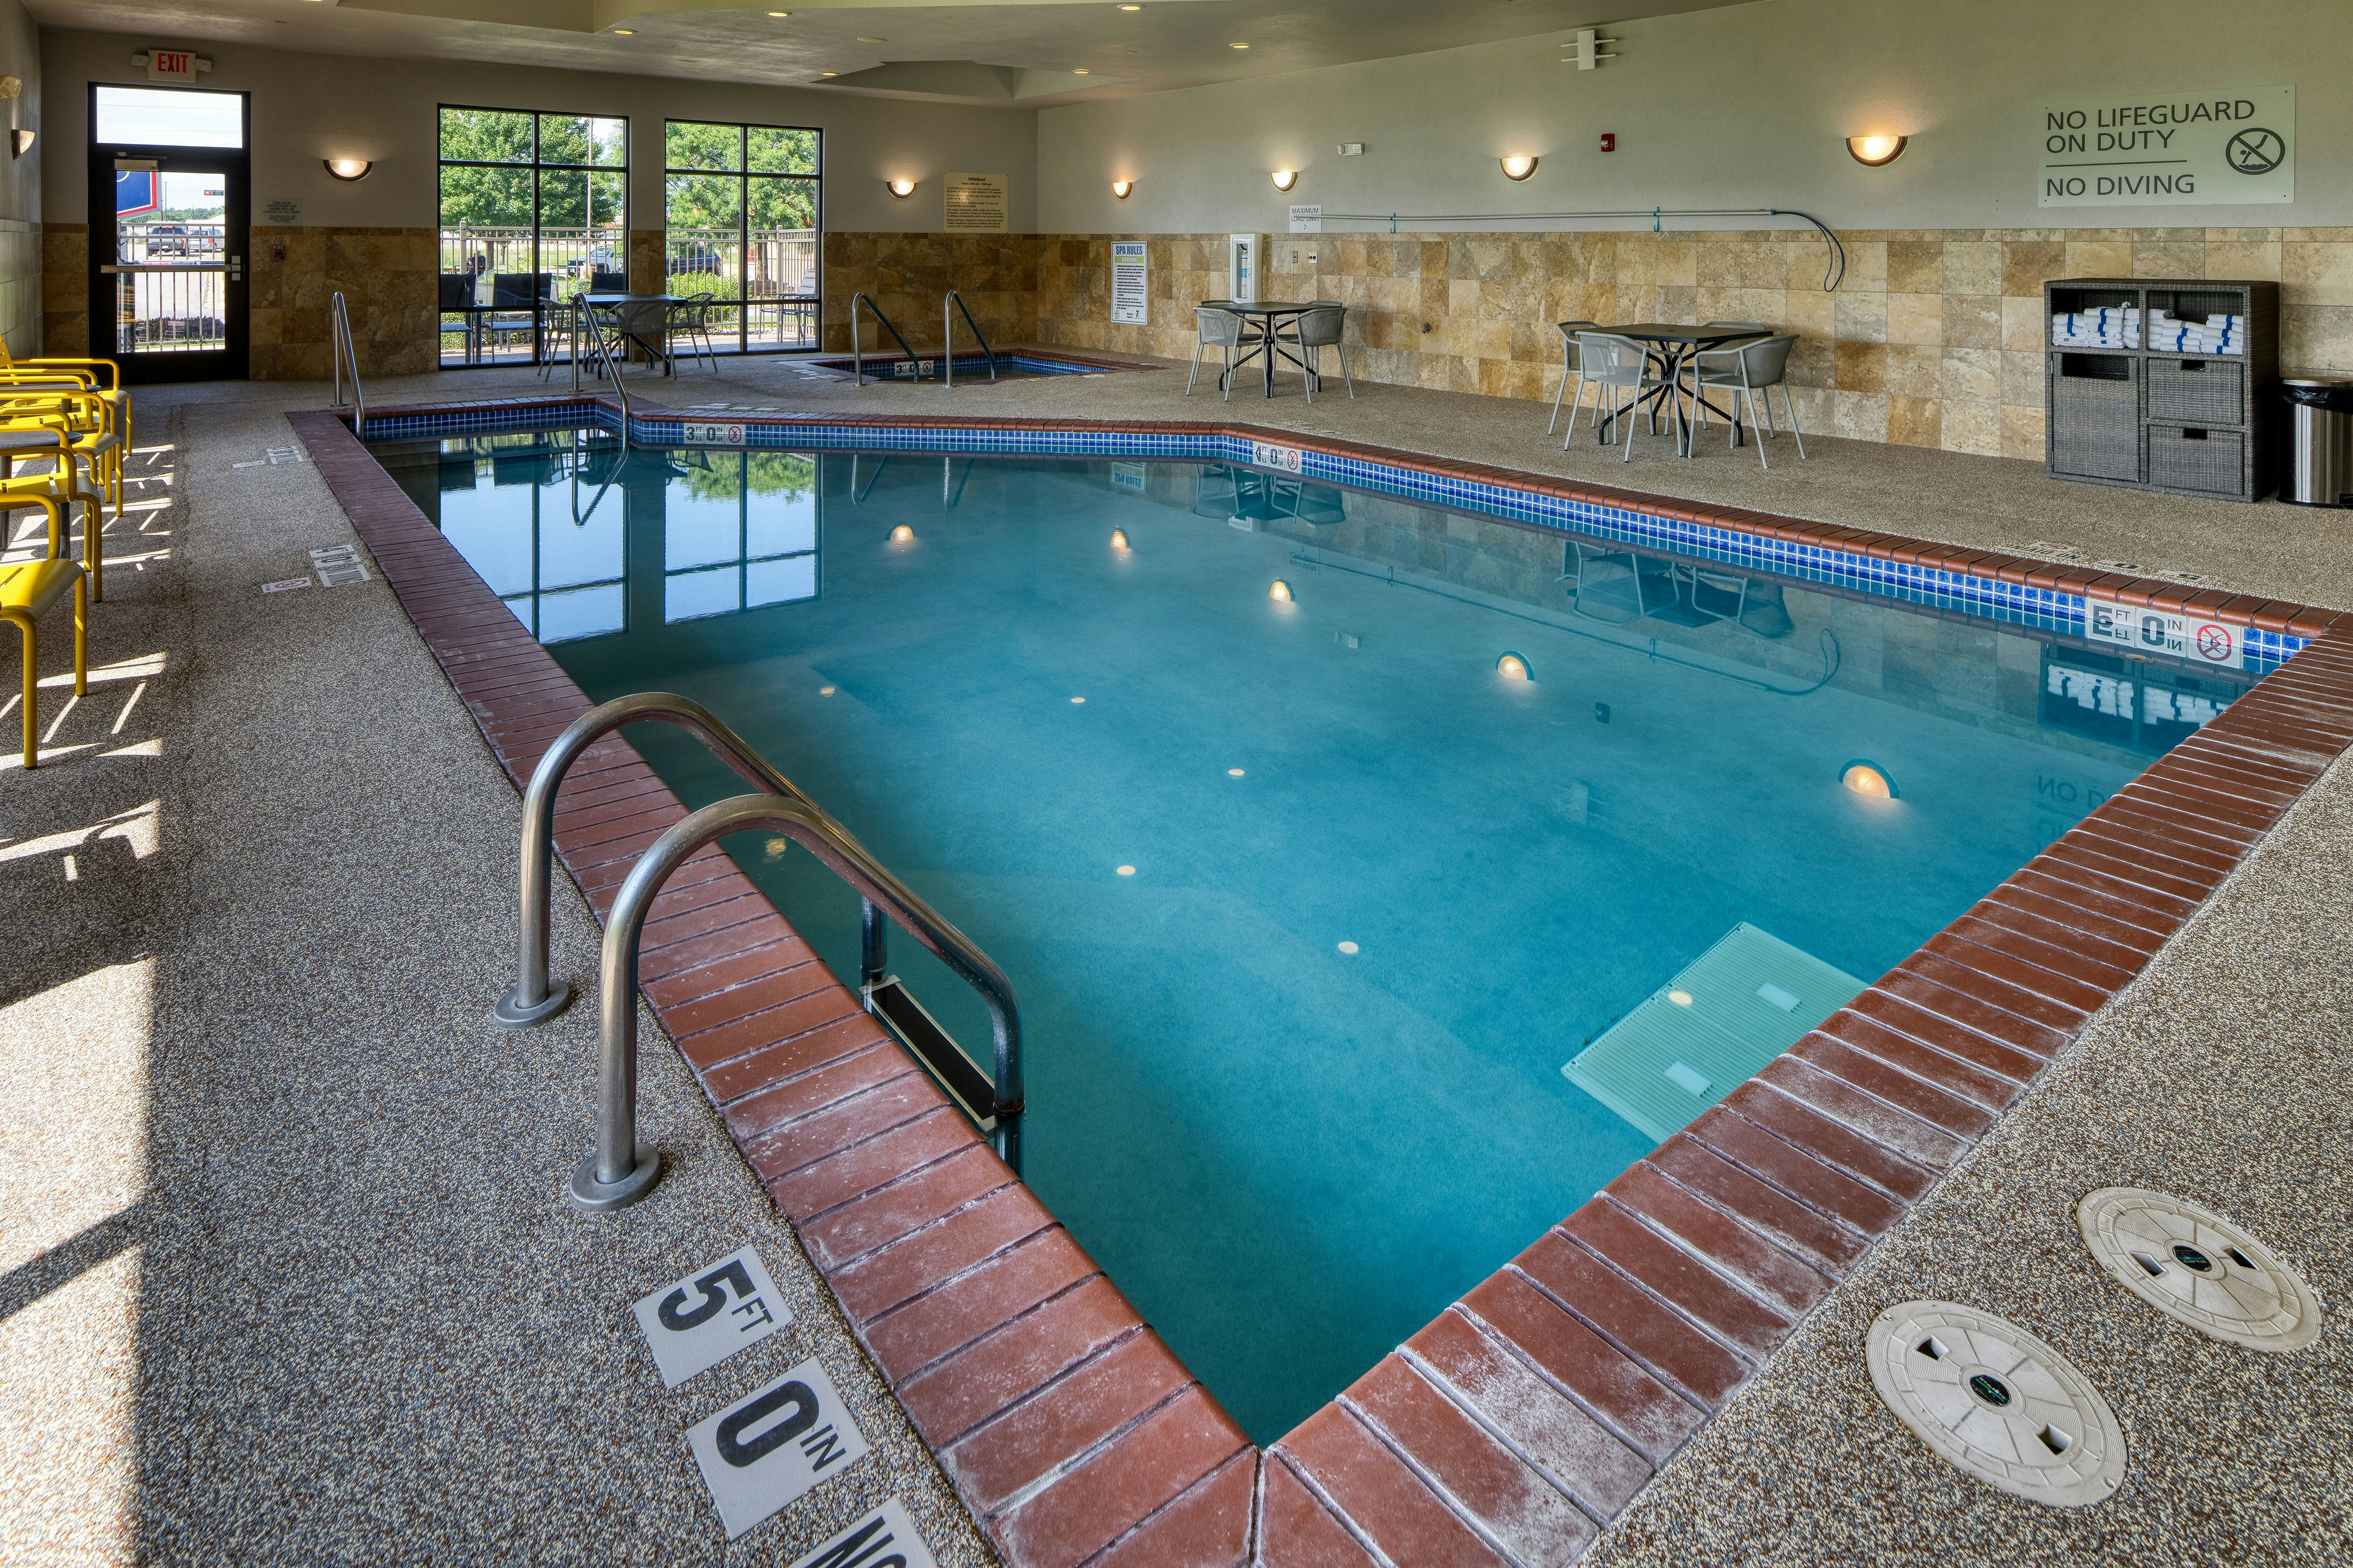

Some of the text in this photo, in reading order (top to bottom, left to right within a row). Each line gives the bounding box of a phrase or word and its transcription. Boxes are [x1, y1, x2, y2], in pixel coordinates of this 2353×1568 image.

[158, 53, 189, 73] EXIT
[2047, 100, 2255, 131] NO LIFEGUARD
[2046, 129, 2176, 153] ON DUTY
[2047, 174, 2194, 196] NO DIVING
[1116, 246, 1142, 255] SPA RULES
[897, 365, 902, 373] 3
[686, 426, 695, 440] 3
[706, 427, 715, 441] 0
[1270, 448, 1278, 465] 0
[2116, 609, 2130, 621] FT
[2142, 616, 2165, 646] 0
[2168, 619, 2182, 631] IN
[658, 1259, 774, 1333] 5 FT
[716, 1380, 847, 1473] 0 IN
